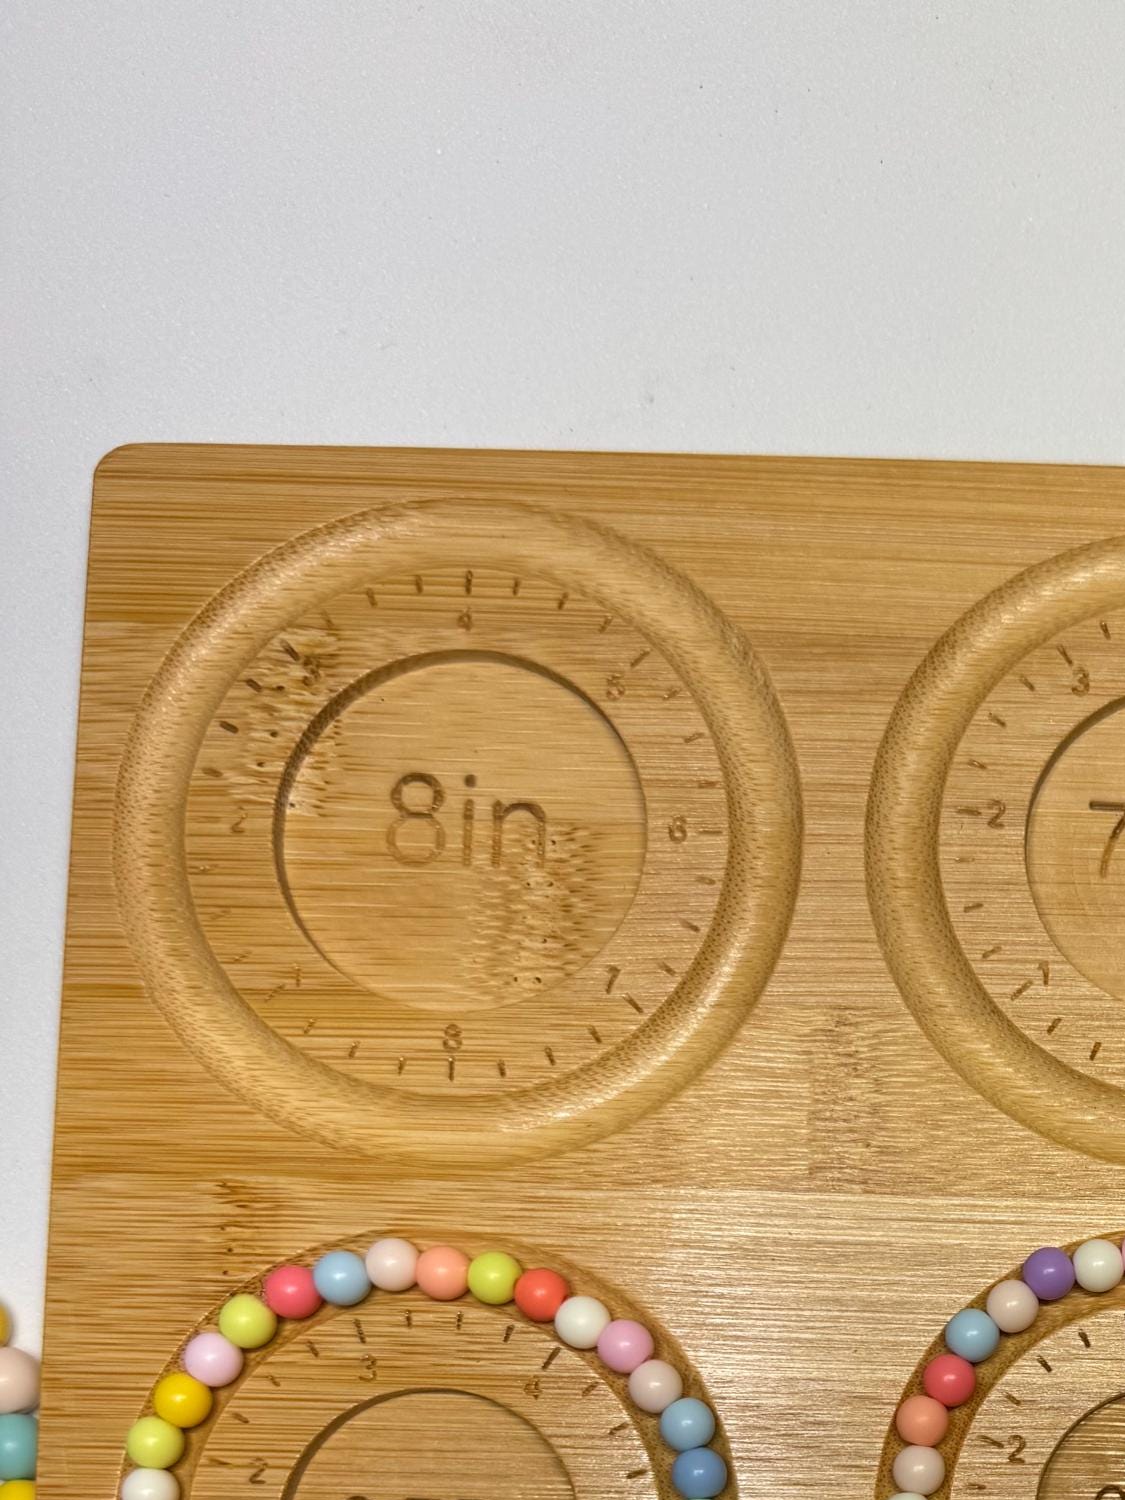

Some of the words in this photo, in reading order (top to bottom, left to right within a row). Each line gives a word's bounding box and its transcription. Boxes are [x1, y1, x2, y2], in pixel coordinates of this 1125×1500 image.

[457, 606, 474, 631] 4
[1071, 666, 1091, 696] 3
[386, 771, 548, 868] 8in
[986, 801, 1008, 829] 2
[668, 816, 688, 843] 6
[607, 965, 622, 995] 7
[443, 1023, 463, 1053] 8
[360, 1354, 378, 1382] 3
[524, 1376, 542, 1400] 4
[1007, 1434, 1027, 1463] 2
[248, 1457, 267, 1485] 2
